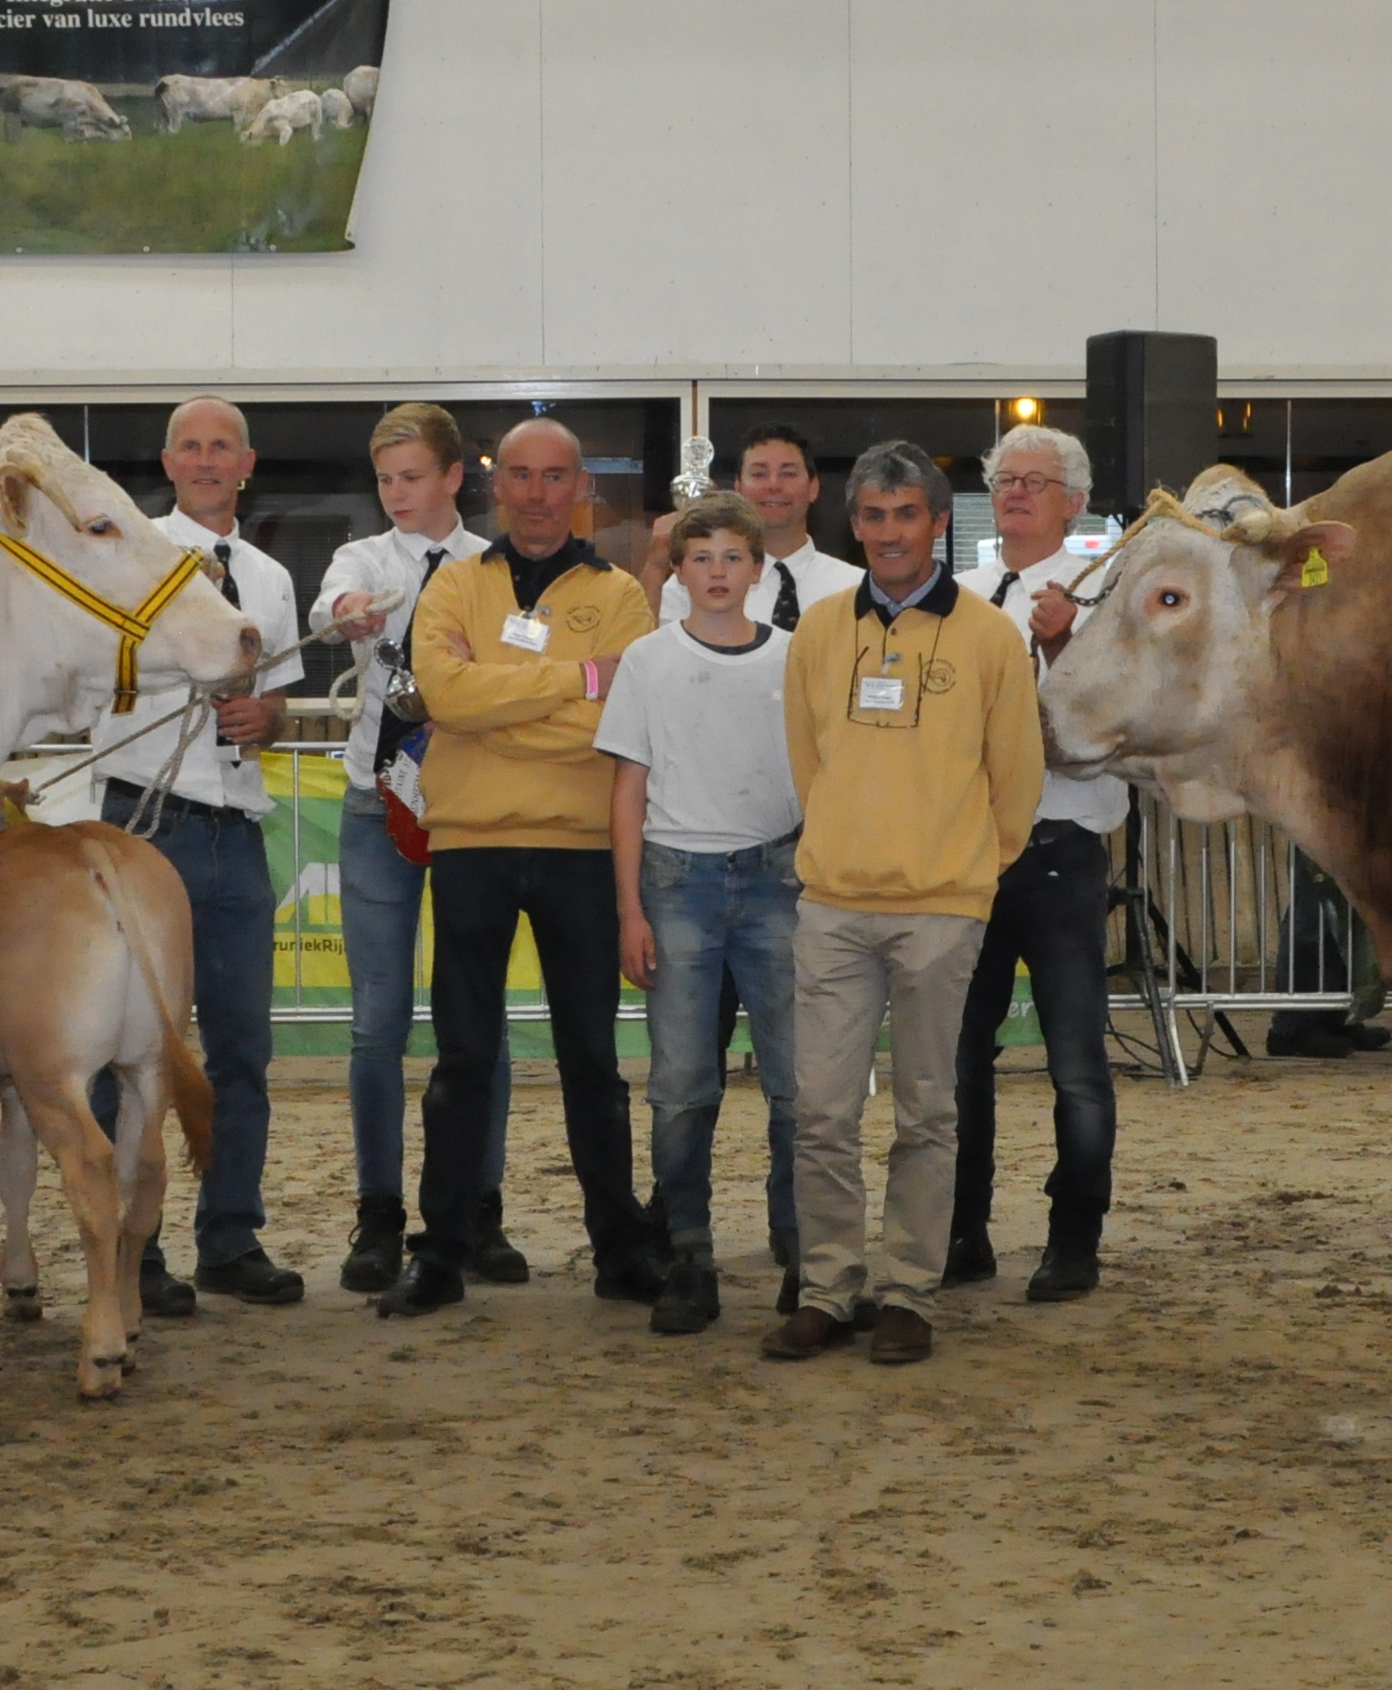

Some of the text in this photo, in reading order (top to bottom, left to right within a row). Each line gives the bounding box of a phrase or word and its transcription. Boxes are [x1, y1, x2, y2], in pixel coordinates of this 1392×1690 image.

[43, 13, 81, 28] van
[87, 9, 133, 28] luxe
[139, 8, 245, 28] rundvlees
